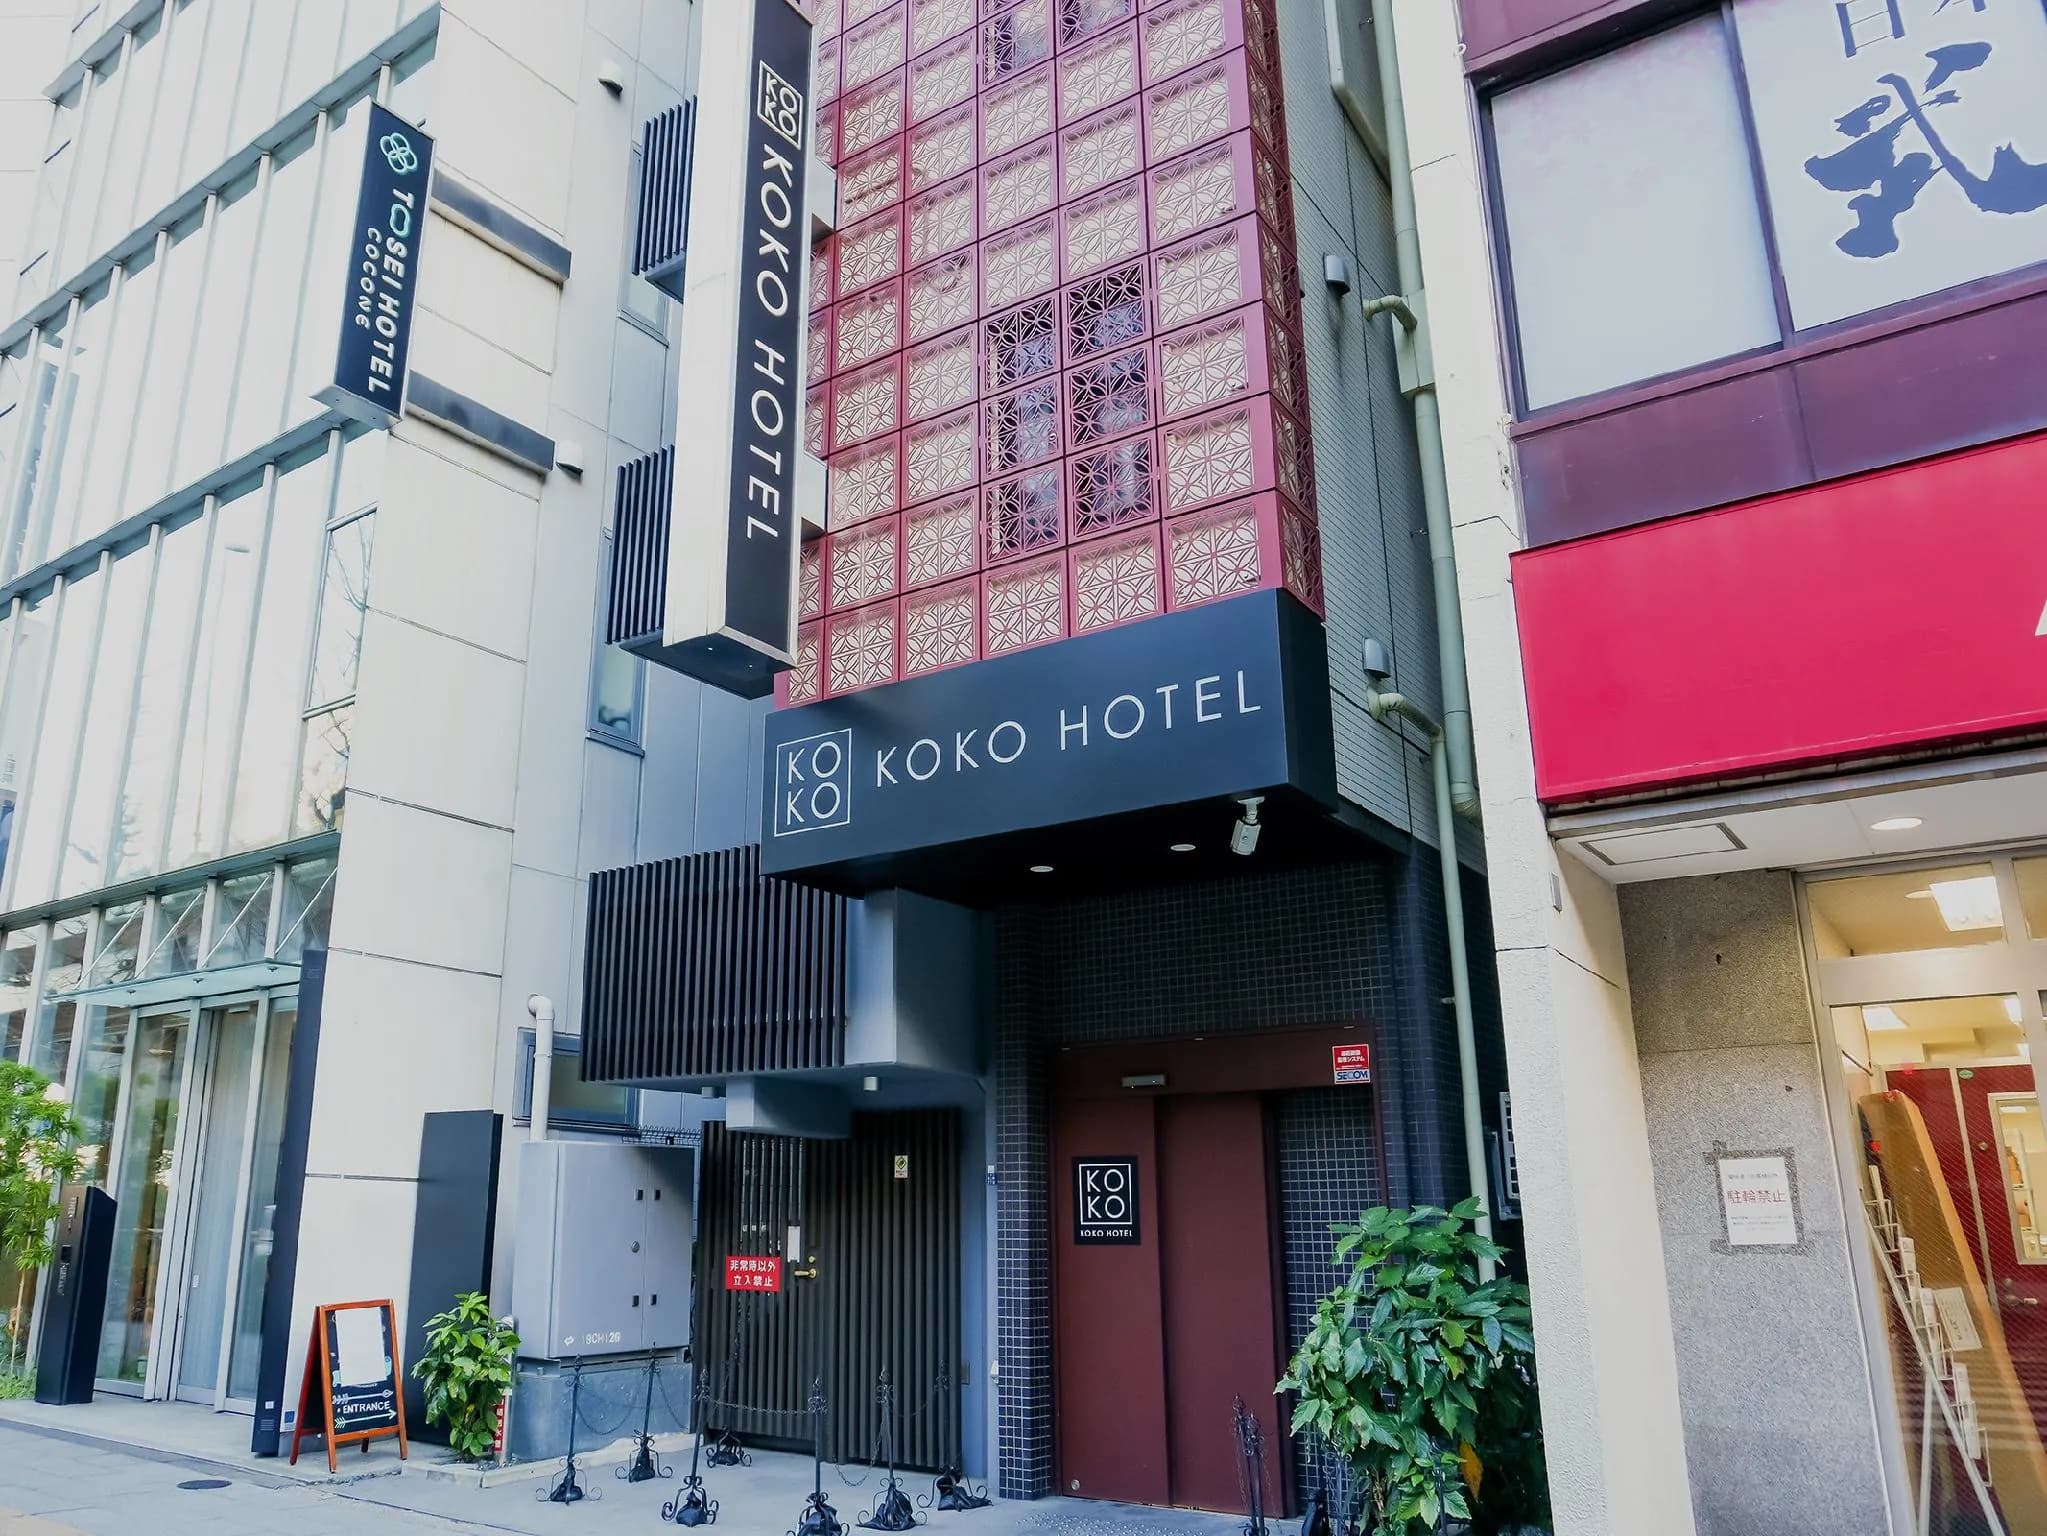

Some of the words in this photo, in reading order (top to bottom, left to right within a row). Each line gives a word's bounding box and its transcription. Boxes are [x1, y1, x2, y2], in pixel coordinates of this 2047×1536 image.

[766, 72, 798, 114] KO
[764, 98, 797, 137] KO
[381, 188, 415, 291] TOSEI
[756, 143, 793, 317] KOKO
[367, 291, 401, 393] HOTEL
[747, 338, 786, 540] HOTEL
[875, 720, 1027, 788] KOKO
[1059, 670, 1262, 751] HOTEL
[787, 740, 842, 785] KO
[786, 781, 841, 826] KO
[1336, 1070, 1368, 1080] SECOM
[1086, 1168, 1125, 1192] KO
[1727, 1188, 1786, 1204] 駐輪禁止
[1087, 1194, 1125, 1218] KO
[1080, 1229, 1104, 1237] KOKO
[1106, 1229, 1132, 1237] HOTEL
[730, 1259, 775, 1272] 非常時以外
[733, 1275, 773, 1287] 立入禁止
[342, 1400, 391, 1414] ENTRANCE
